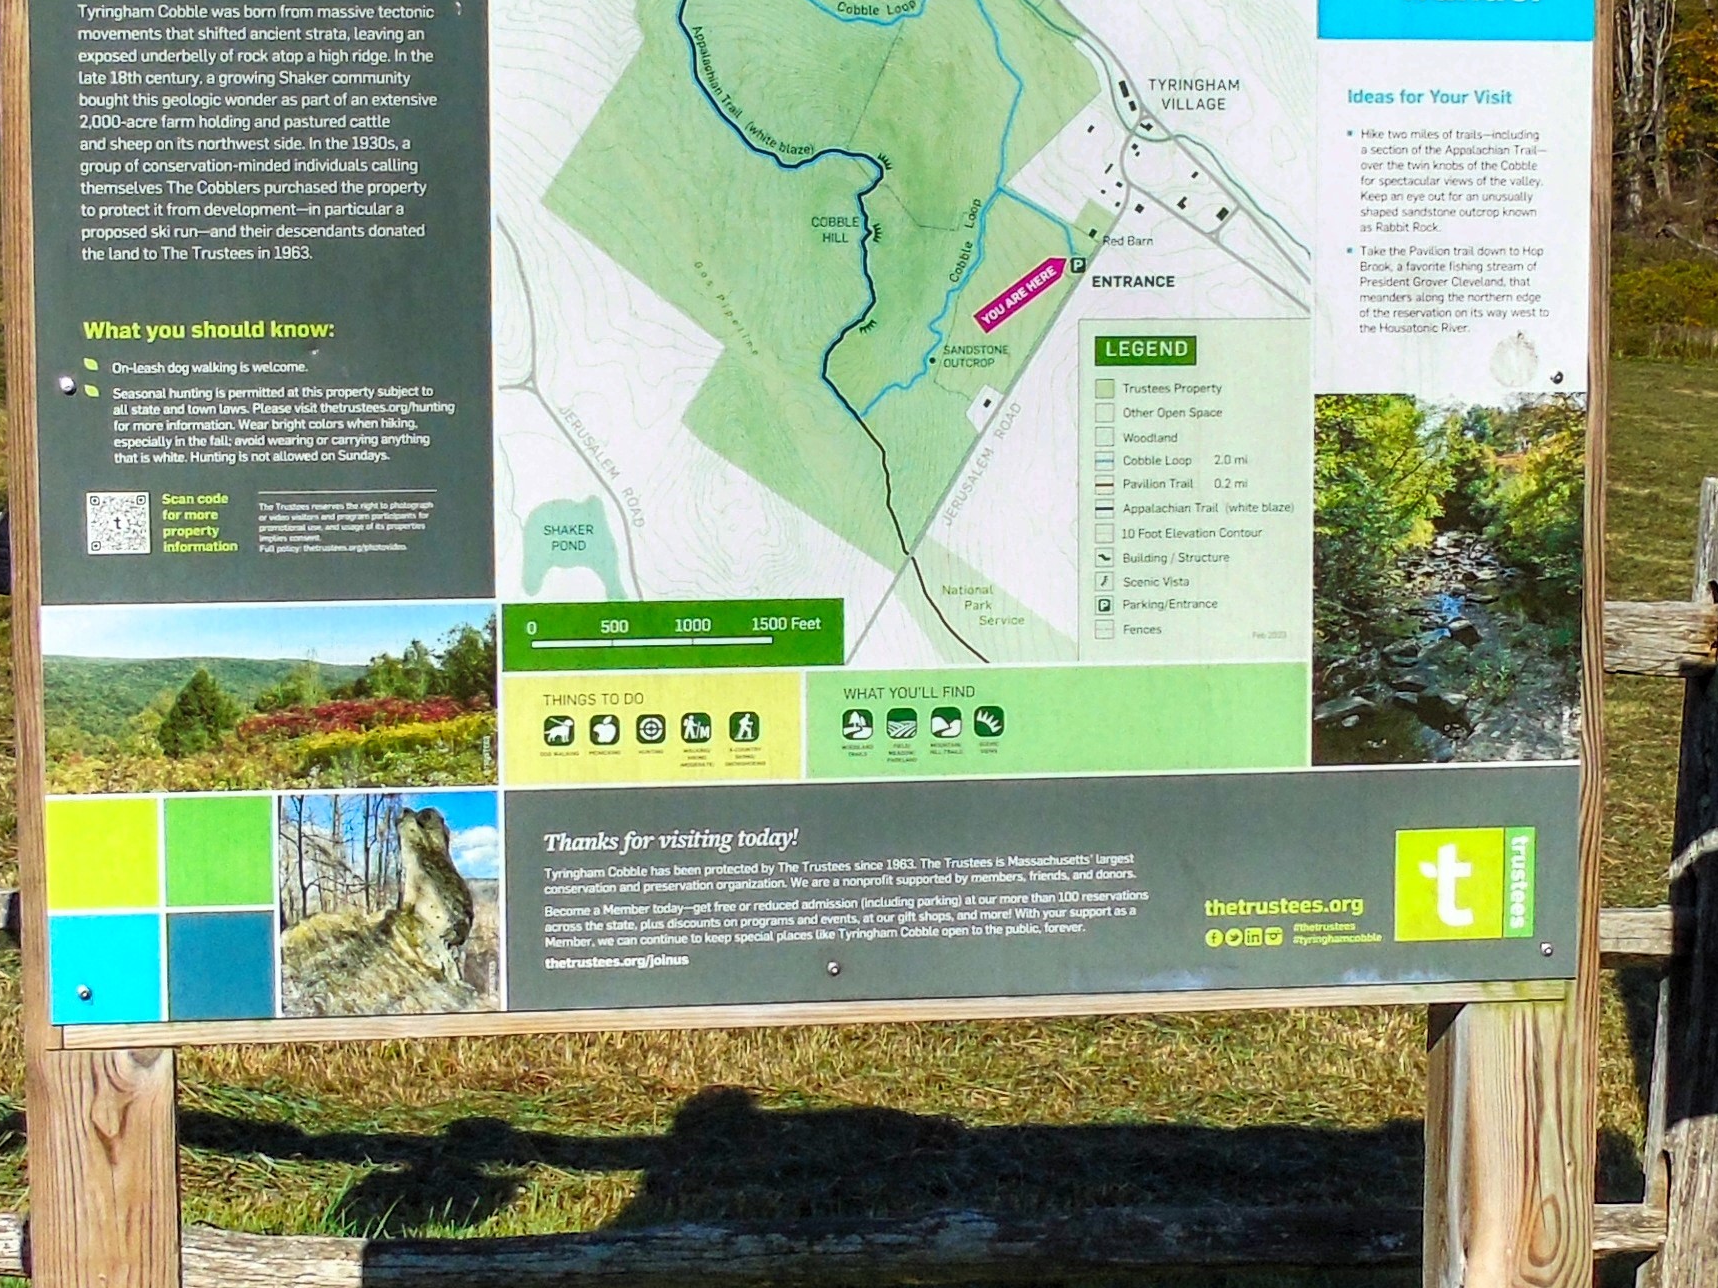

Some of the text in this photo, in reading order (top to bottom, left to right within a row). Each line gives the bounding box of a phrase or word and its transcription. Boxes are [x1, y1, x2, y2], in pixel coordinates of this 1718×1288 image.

[76, 3, 434, 21] Tyringham Cobble was born from massive tectonic
[1148, 78, 1239, 91] TYRINGHAM
[1348, 89, 1511, 104] Ideas for Your Visit
[1161, 97, 1225, 110] VILLAGE
[811, 216, 859, 227] COBBLE
[822, 232, 848, 243] HILL
[1101, 234, 1152, 246] Red Barn
[1092, 275, 1174, 287] ENTRANCE
[981, 266, 1057, 324] YOU ARE HERE
[82, 320, 333, 342] What you should know:
[1106, 340, 1187, 356] LEGEND
[112, 361, 308, 376] On-leash dog walking is welcome.
[1122, 382, 1222, 394] Trustees Property
[1122, 407, 1222, 419] Other Open Space
[1122, 432, 1178, 443] Woodland
[1123, 454, 1247, 466] Cobble Loop 2.0 mi
[1123, 477, 1247, 489] Pavilion Trail 0.2 mi
[161, 492, 228, 504] Scan code
[162, 509, 219, 520] for more
[162, 525, 219, 538] property
[543, 524, 593, 535] SHAKER
[163, 540, 237, 552] information
[551, 540, 586, 551] POND
[526, 621, 536, 635] 0
[600, 619, 628, 633] 500
[675, 618, 711, 632] 1000
[752, 616, 820, 630] 1500 Feet
[843, 685, 974, 699] WHAT YOU'LL FIND
[542, 692, 643, 706] THINGS TO DO
[543, 827, 798, 855] Thanks for visiting today!
[1510, 835, 1527, 927] trustees
[1204, 898, 1363, 915] thetrustees.org
[544, 953, 689, 968] thetrustees.org/joinus
